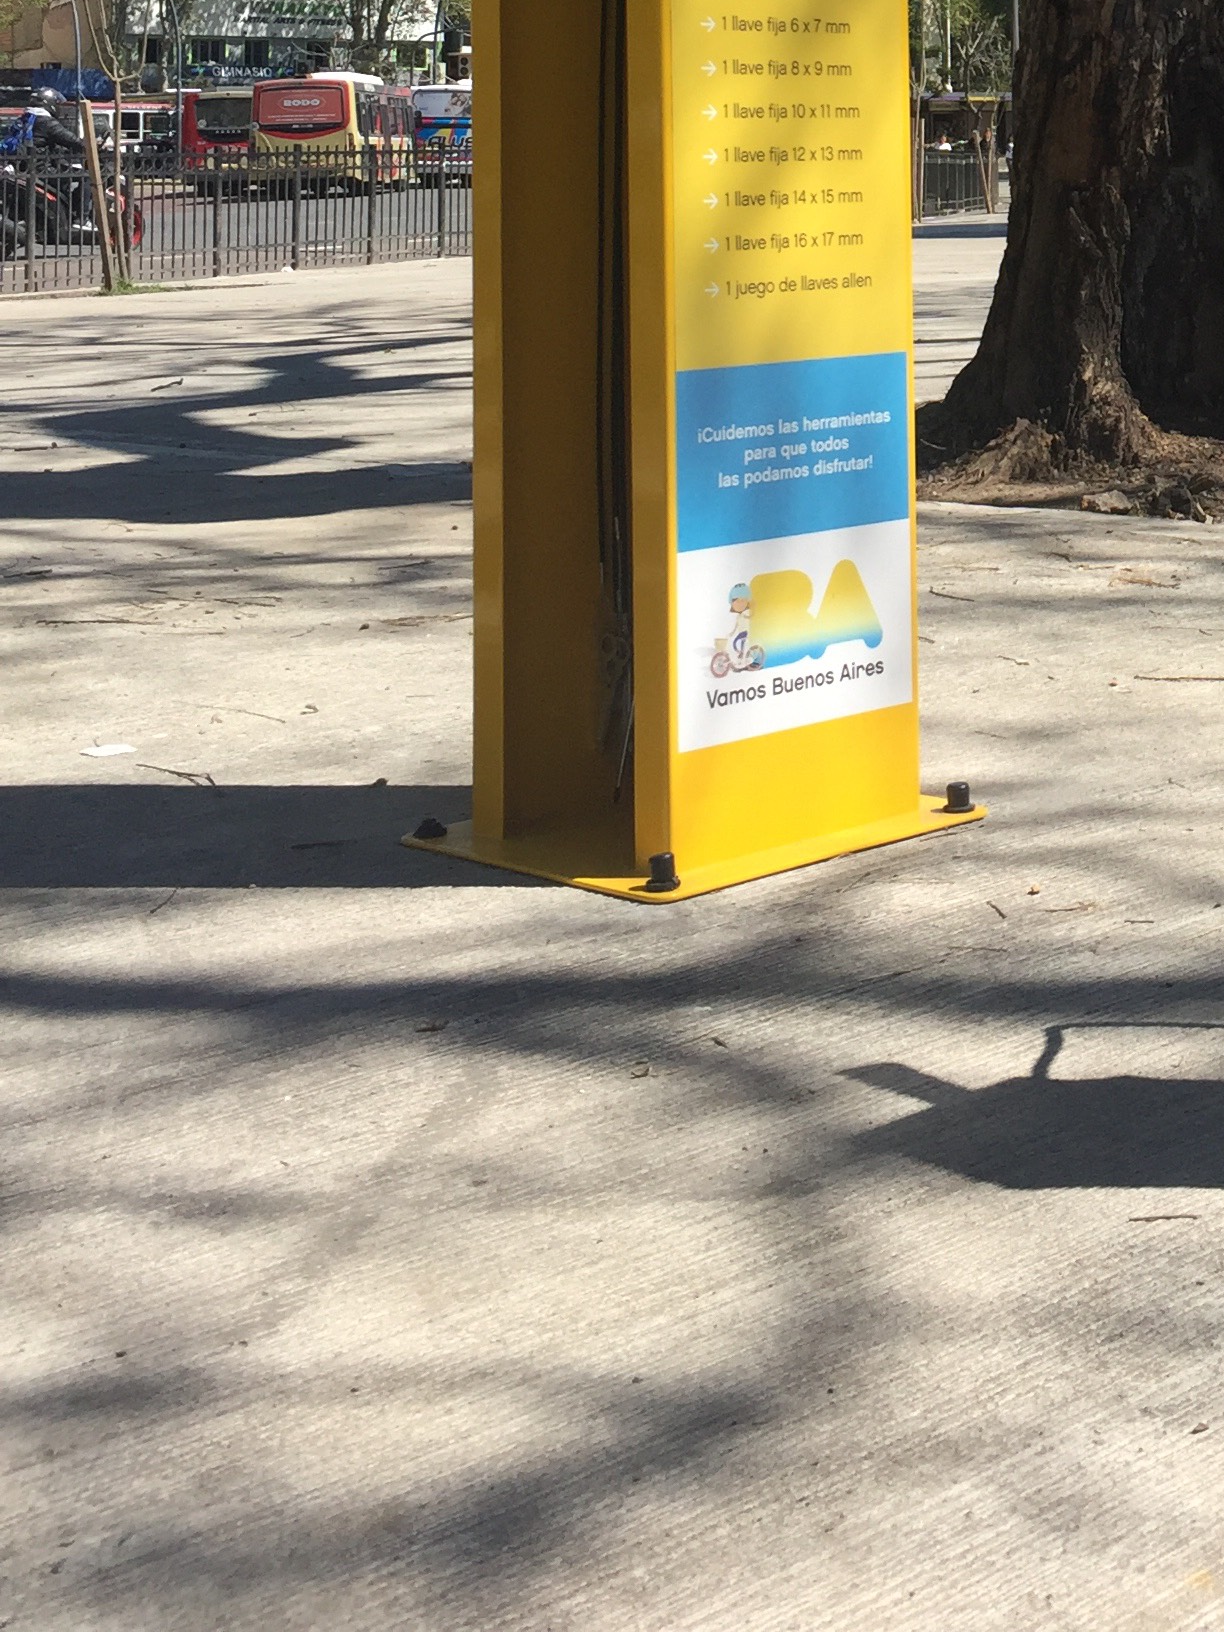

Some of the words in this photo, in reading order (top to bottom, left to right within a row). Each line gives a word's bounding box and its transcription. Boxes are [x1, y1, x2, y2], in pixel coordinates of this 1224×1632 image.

[722, 16, 727, 30] 1
[732, 15, 763, 31] llave
[767, 17, 786, 36] fija
[790, 17, 798, 33] 6
[802, 21, 810, 33] x
[814, 18, 822, 33] 7
[825, 22, 851, 34] mm
[722, 60, 728, 75] 1
[732, 59, 764, 75] llave
[768, 60, 787, 79] fija
[791, 60, 800, 76] 8
[803, 64, 811, 76] x
[814, 60, 823, 76] 9
[826, 64, 852, 76] mm
[723, 104, 728, 118] 1
[733, 103, 765, 119] llave
[768, 103, 788, 123] fija
[792, 104, 806, 119] 10
[809, 107, 817, 118] x
[820, 104, 831, 118] 11
[835, 107, 860, 118] mm
[724, 148, 729, 162] 1
[734, 146, 765, 163] llave
[769, 146, 789, 166] fija
[792, 146, 806, 162] 12
[810, 150, 817, 161] x
[820, 146, 834, 161] 13
[838, 149, 863, 161] mm
[725, 192, 730, 207] 1
[735, 190, 766, 207] llave
[770, 190, 789, 209] fija
[793, 190, 806, 204] 14
[810, 193, 818, 204] x
[821, 189, 834, 204] 15
[838, 191, 863, 203] mm
[725, 236, 730, 251] 1
[735, 235, 766, 251] llave
[771, 233, 790, 253] fija
[794, 233, 807, 248] 16
[811, 236, 818, 247] x
[822, 231, 834, 247] 17
[838, 233, 863, 246] mm
[726, 281, 731, 295] 1
[735, 280, 775, 299] juego
[779, 277, 797, 292] de
[801, 275, 838, 291] llaves
[842, 272, 872, 288] allen
[698, 423, 774, 443] ¡Cuidemos
[778, 419, 799, 434] las
[803, 410, 891, 431] herramientas
[744, 447, 776, 465] para
[780, 442, 807, 460] que
[811, 436, 849, 453] todos
[718, 472, 739, 488] las
[744, 465, 809, 489] podamos
[813, 454, 873, 475] disfrutar!
[706, 684, 766, 709] Vamos
[772, 670, 834, 695] Buenos
[839, 660, 885, 681] Aires
